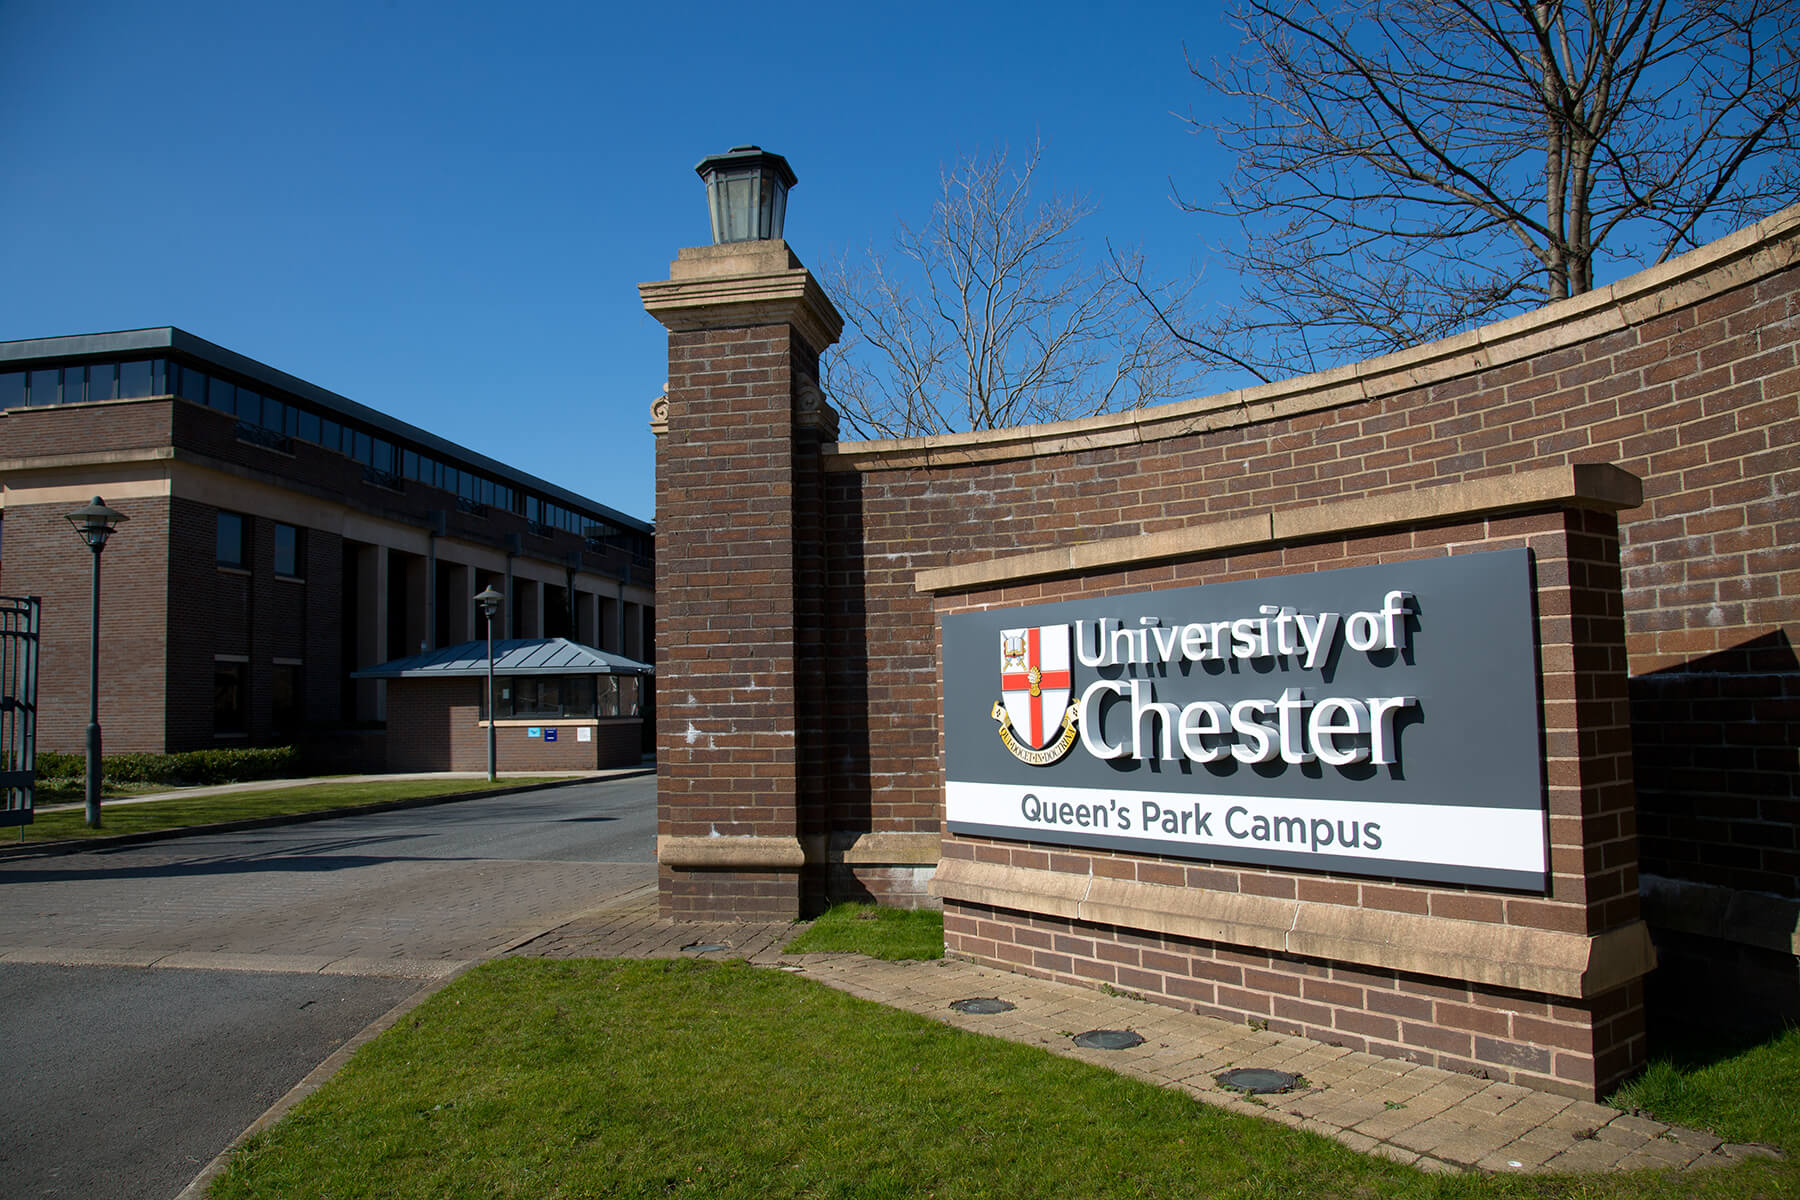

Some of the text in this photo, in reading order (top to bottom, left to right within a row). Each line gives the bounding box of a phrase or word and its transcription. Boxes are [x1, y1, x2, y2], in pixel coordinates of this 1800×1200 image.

[1075, 590, 1413, 669] University of
[1079, 679, 1416, 766] Chester
[1021, 793, 1382, 852] Queen's Park Campus
